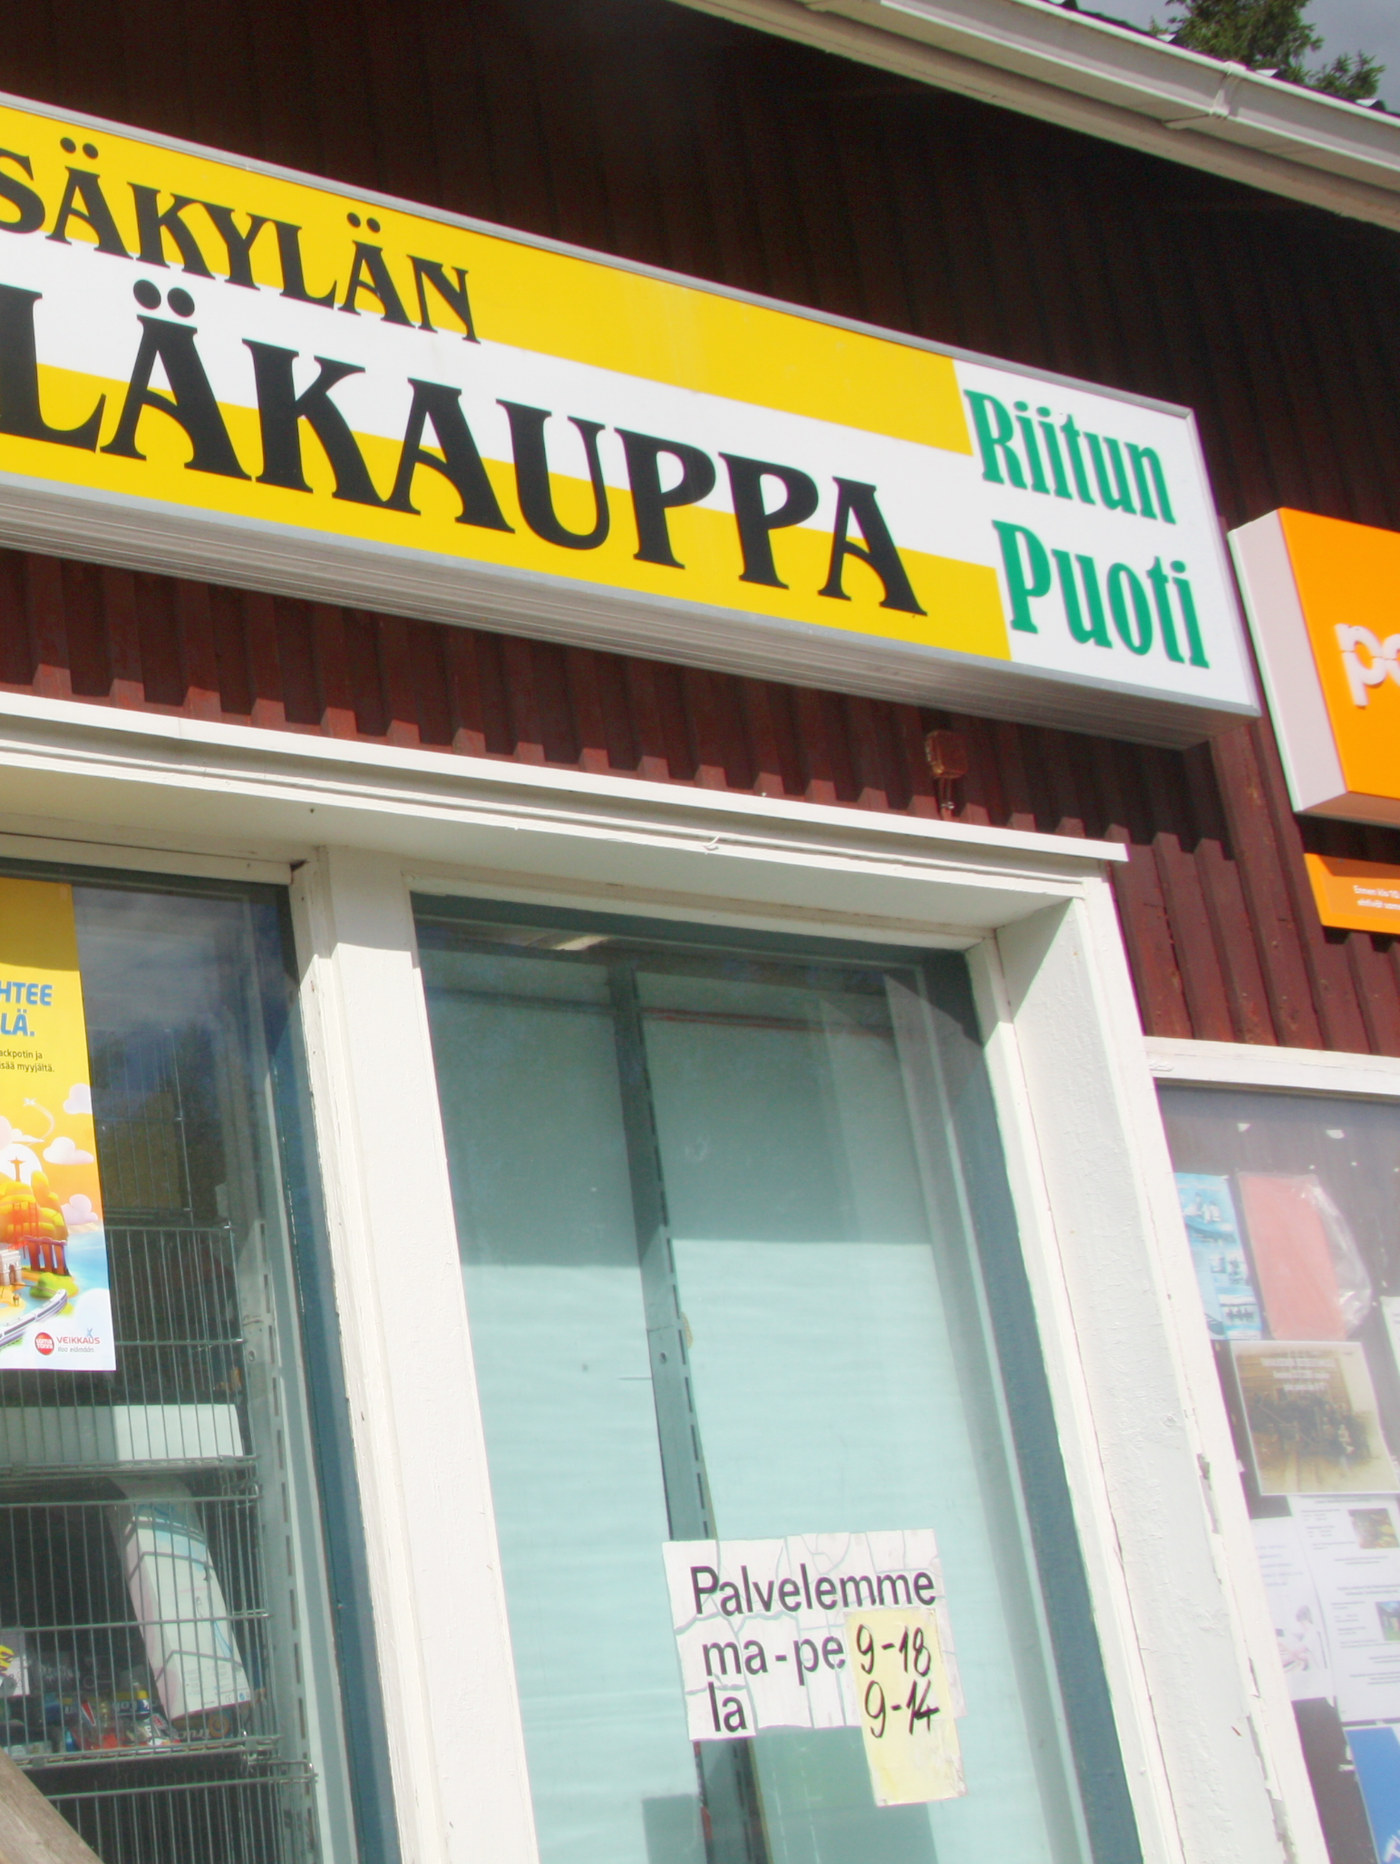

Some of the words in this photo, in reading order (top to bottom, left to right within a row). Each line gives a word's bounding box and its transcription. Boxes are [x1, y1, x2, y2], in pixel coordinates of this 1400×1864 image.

[964, 388, 1177, 525] Riitun
[992, 519, 1210, 670] Puoti
[34, 1050, 43, 1060] ja
[56, 1336, 101, 1345] VEIKKAUS
[690, 1563, 937, 1617] Palvelemme
[707, 1681, 748, 1733] la
